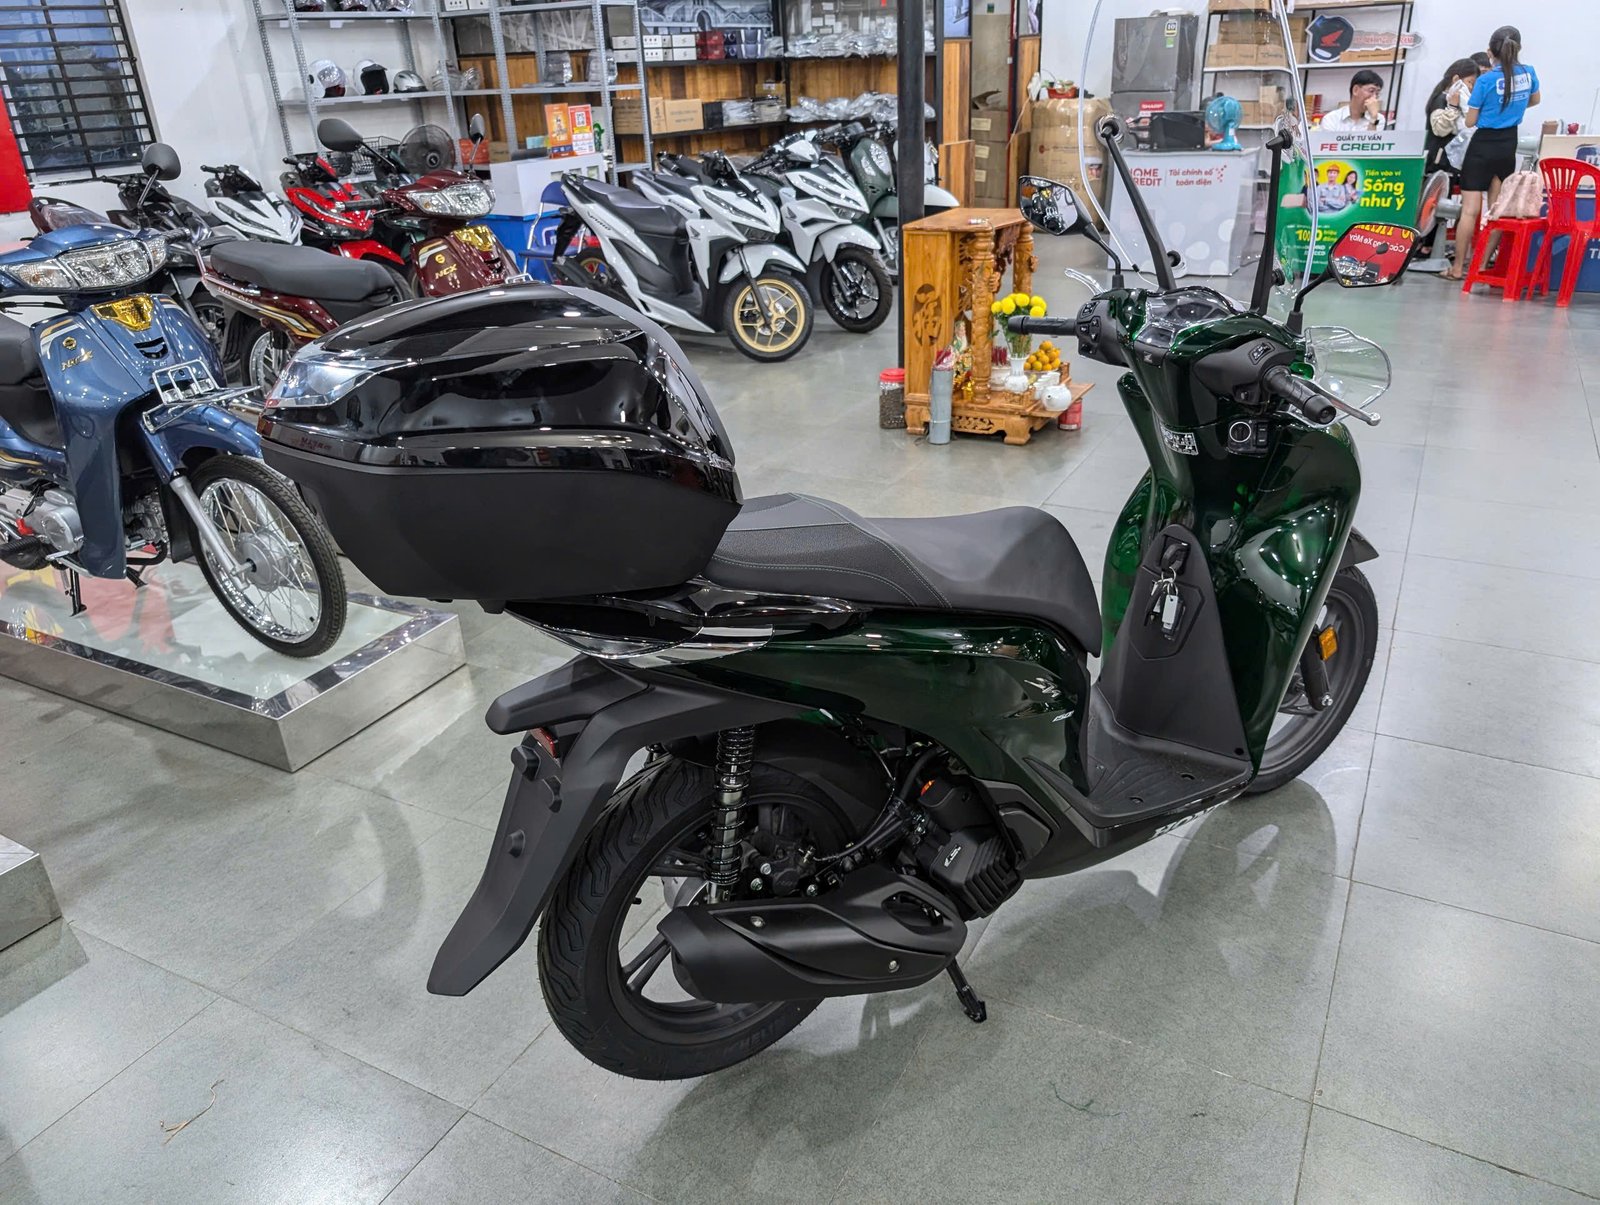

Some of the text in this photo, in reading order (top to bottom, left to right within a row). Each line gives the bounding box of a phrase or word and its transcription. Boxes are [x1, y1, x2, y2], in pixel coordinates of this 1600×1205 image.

[1320, 142, 1395, 151] FE CREDIT
[1363, 176, 1405, 195] Sống
[1360, 194, 1405, 210] như ý
